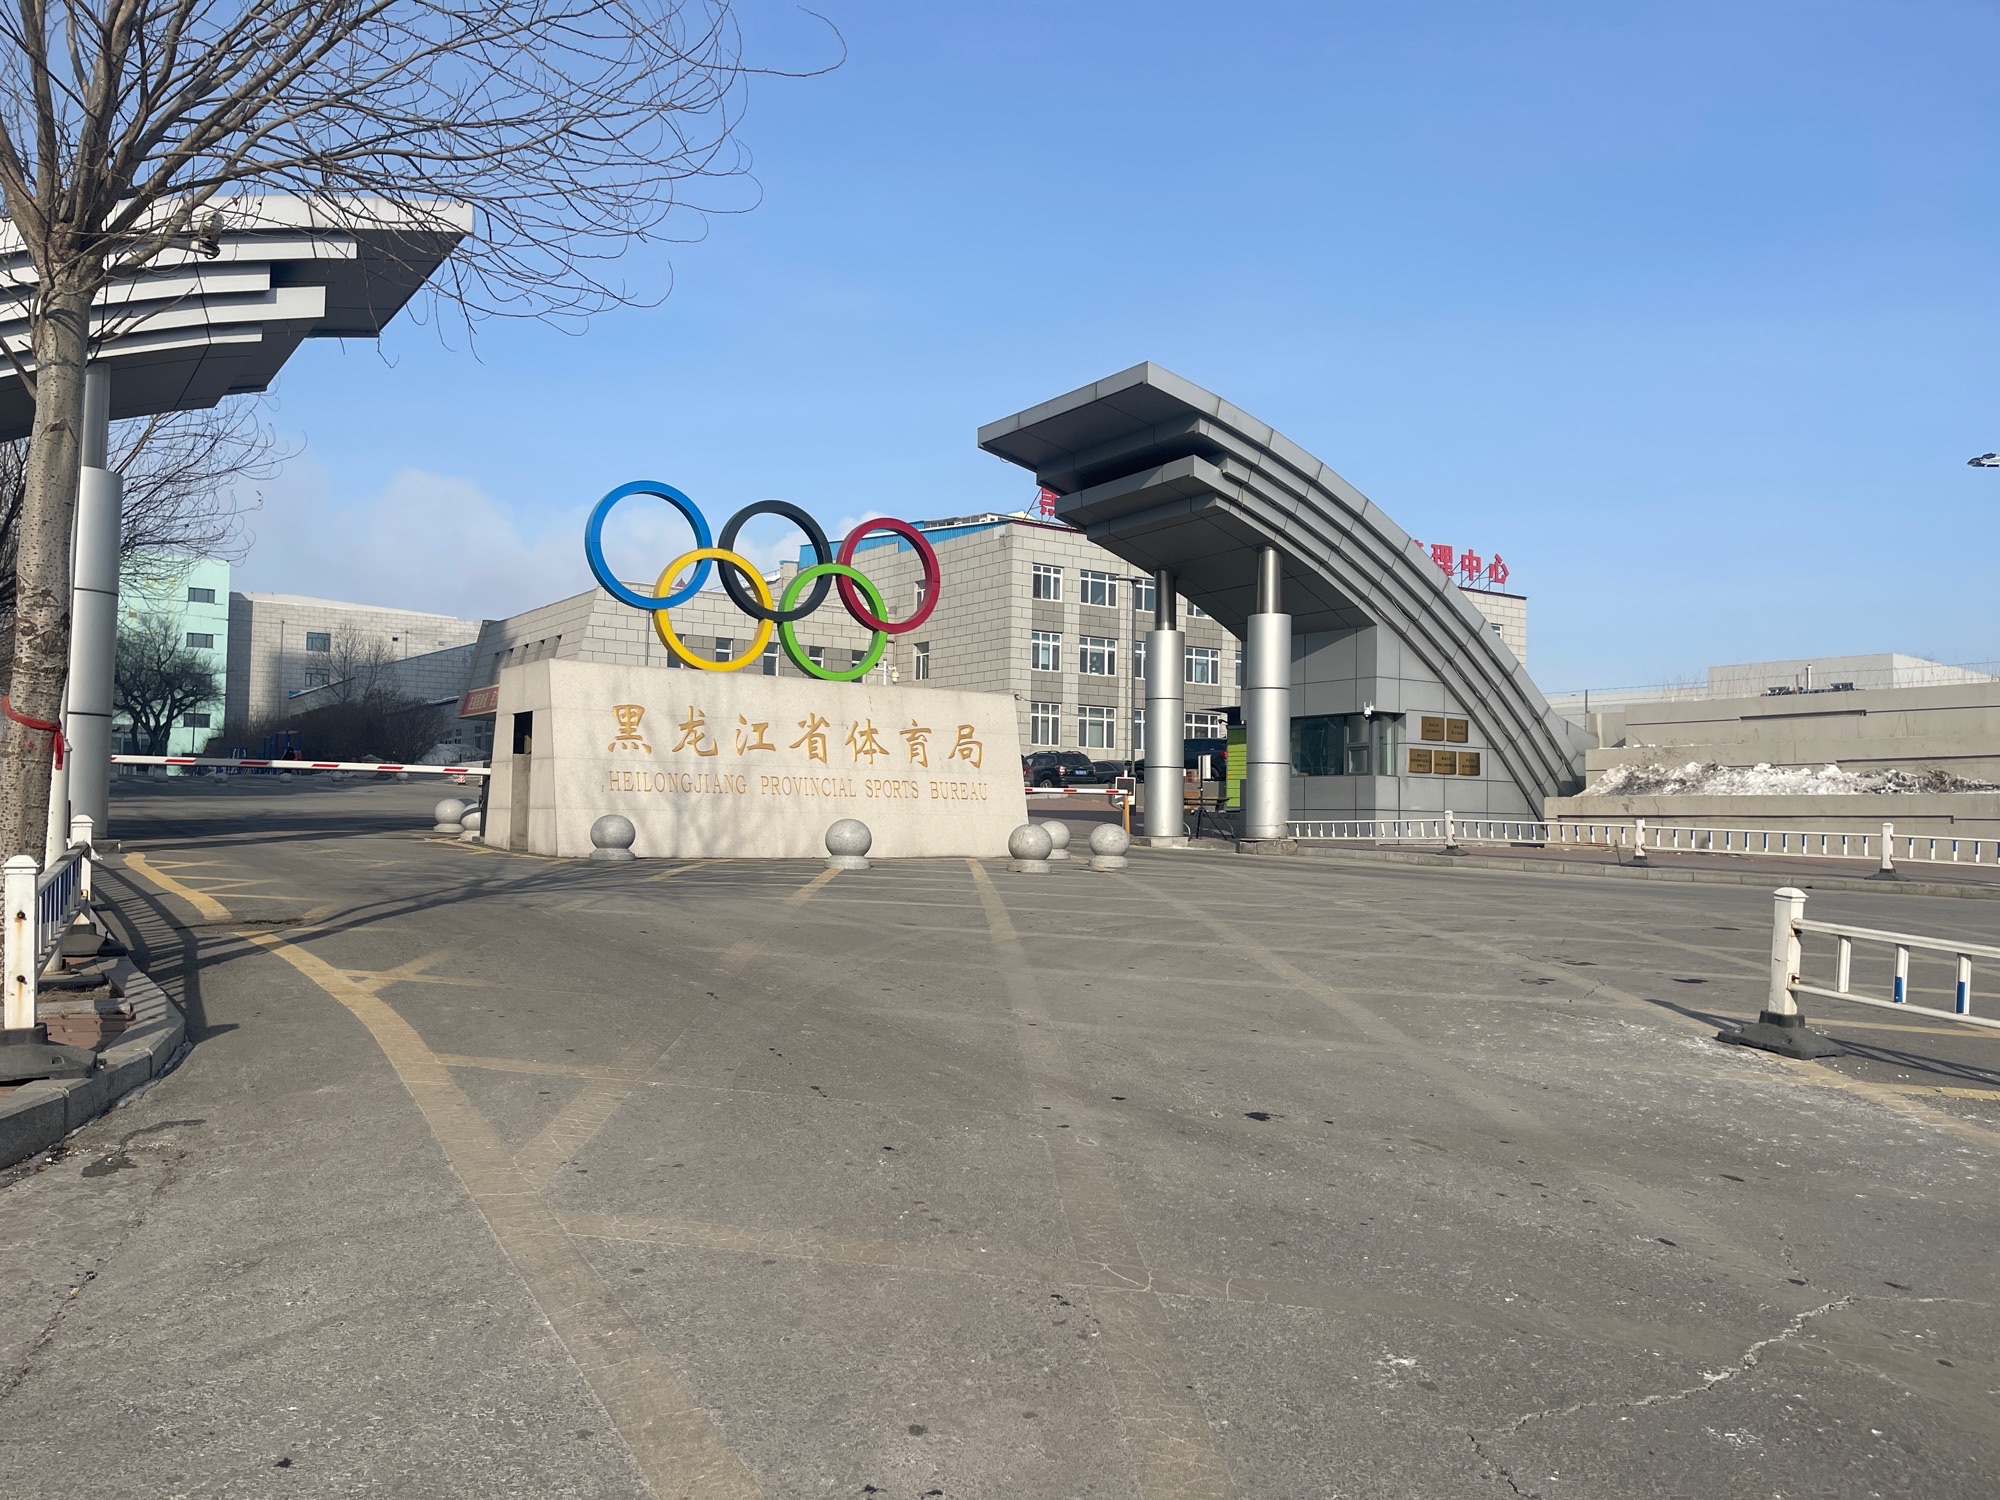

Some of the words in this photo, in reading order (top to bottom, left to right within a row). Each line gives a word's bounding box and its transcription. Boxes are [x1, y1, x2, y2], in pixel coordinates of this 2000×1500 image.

[1413, 539, 1510, 584] 理中心
[607, 703, 984, 769] 黑龙江省体育局
[608, 770, 747, 795] HEILONGJIANG
[760, 775, 857, 798] PROVINCIAL
[865, 778, 920, 799] SPORTS
[930, 781, 988, 801] BUREAU
